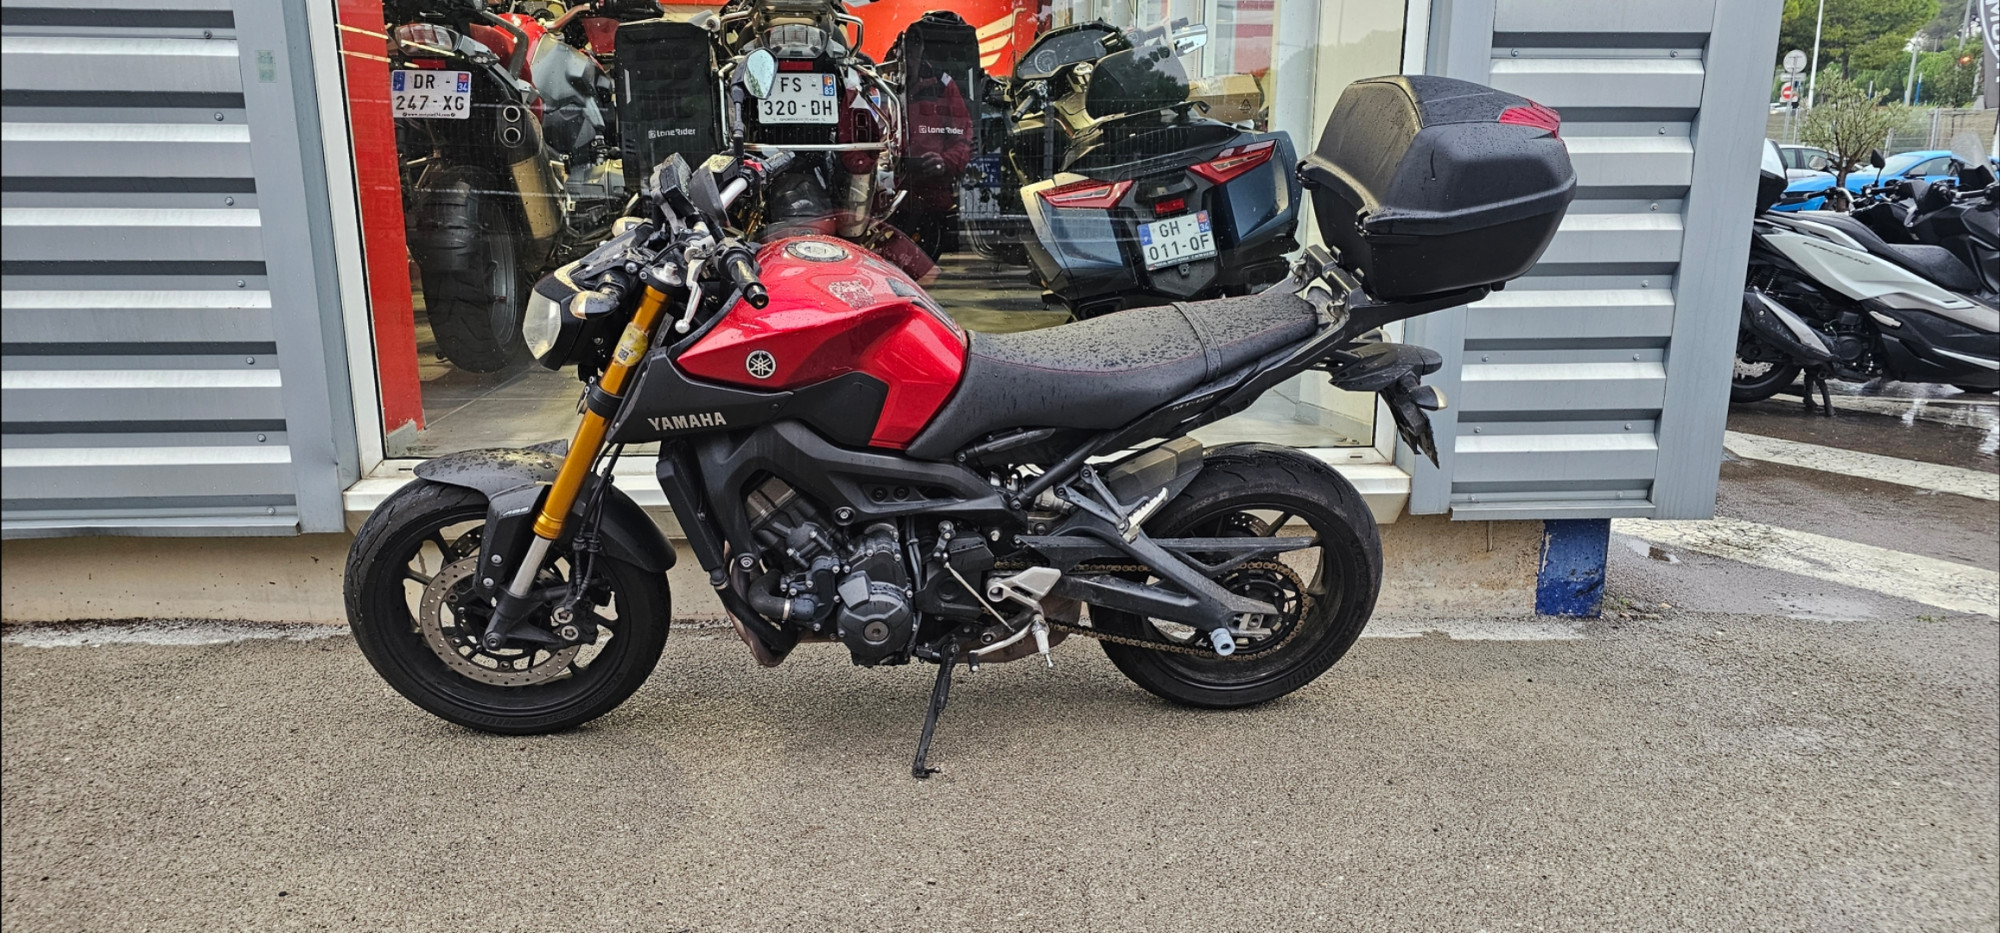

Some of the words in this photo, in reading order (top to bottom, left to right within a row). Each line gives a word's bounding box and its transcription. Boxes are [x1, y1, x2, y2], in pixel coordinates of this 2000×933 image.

[413, 74, 435, 89] DR
[457, 83, 468, 91] 34
[780, 77, 802, 93] FS
[824, 87, 834, 95] 83
[656, 130, 675, 138] Lone
[927, 126, 945, 134] Lone
[1159, 220, 1180, 238] GH
[647, 411, 727, 431] YAMAHA
